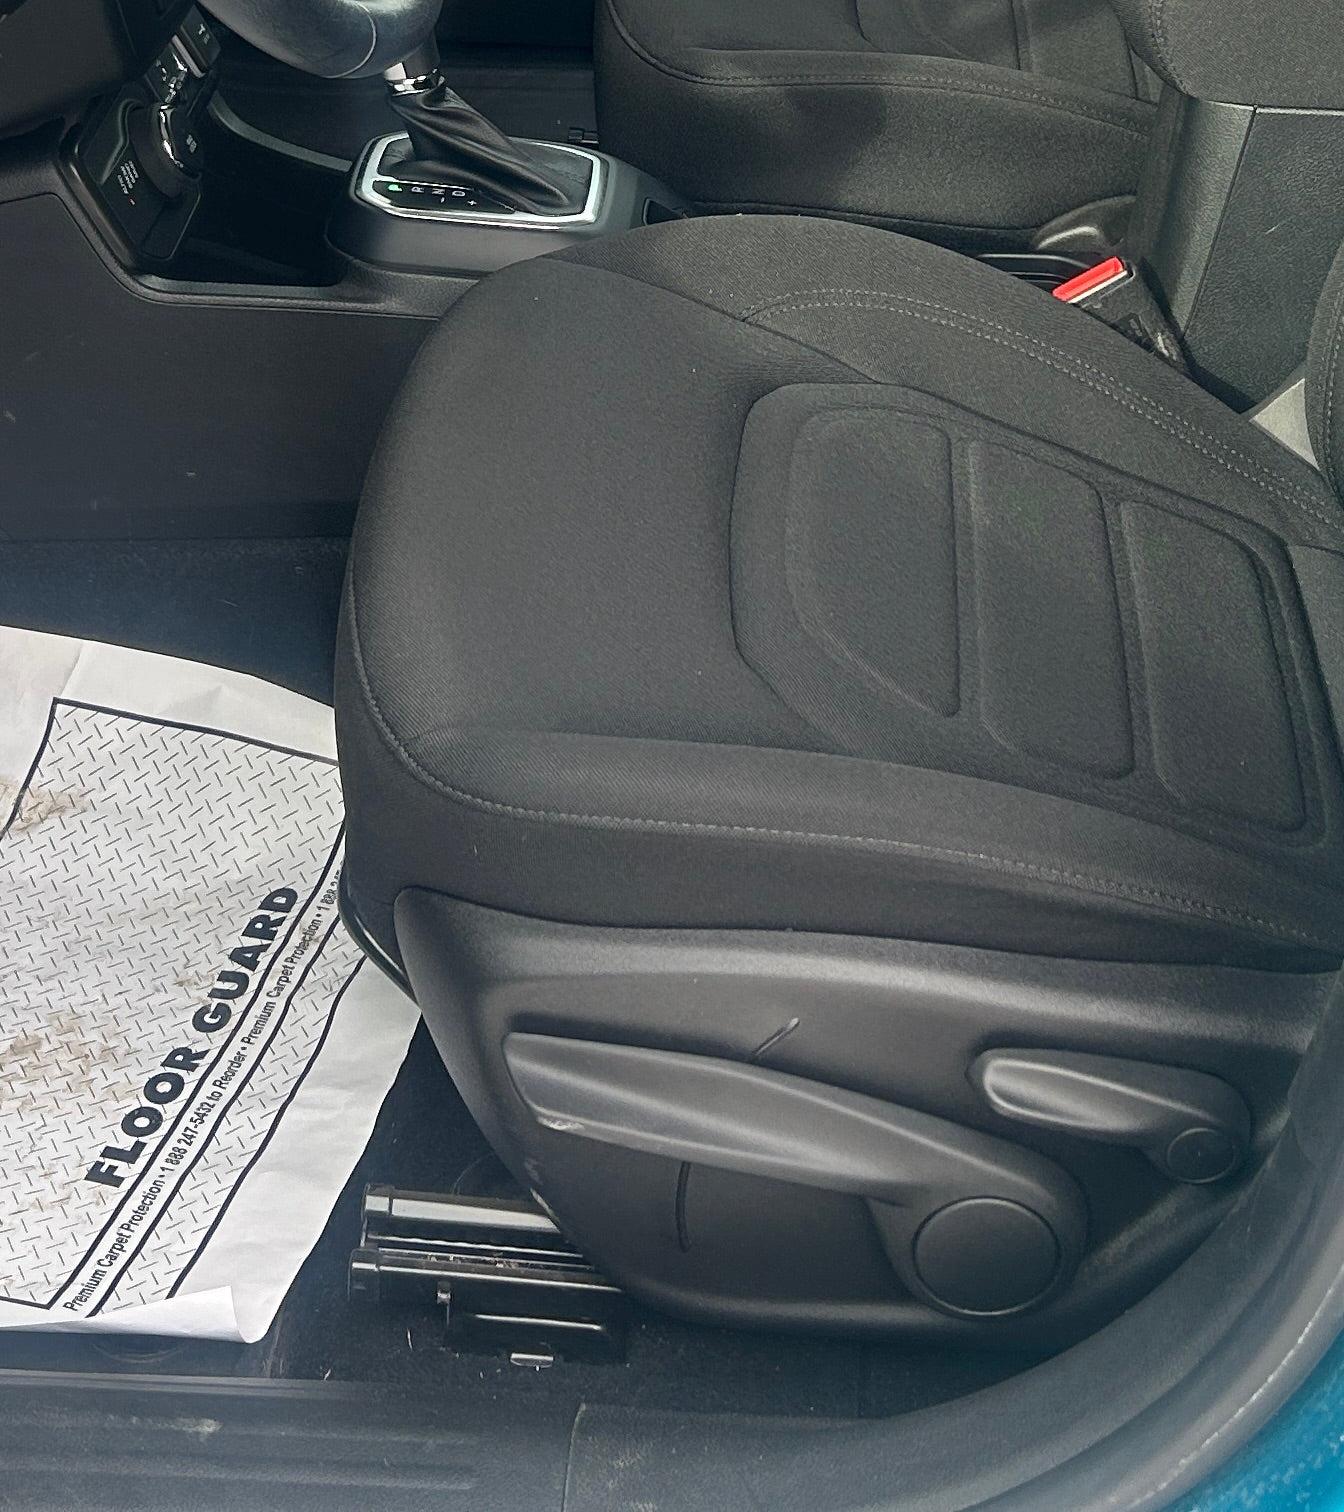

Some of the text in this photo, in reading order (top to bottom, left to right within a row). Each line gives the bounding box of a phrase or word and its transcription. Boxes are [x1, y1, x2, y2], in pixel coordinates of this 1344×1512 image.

[284, 918, 323, 965] Protection
[266, 964, 296, 999] Carpet
[83, 887, 299, 1188] FLOOR GUARD
[241, 1001, 277, 1045] Premium
[212, 1050, 248, 1090] Reorder
[206, 1090, 224, 1102] to
[177, 1101, 216, 1147] 247-5432
[165, 1146, 188, 1166] 888
[118, 1178, 166, 1234] Protection
[96, 1232, 132, 1268] Carpet
[62, 1268, 107, 1312] Premium
